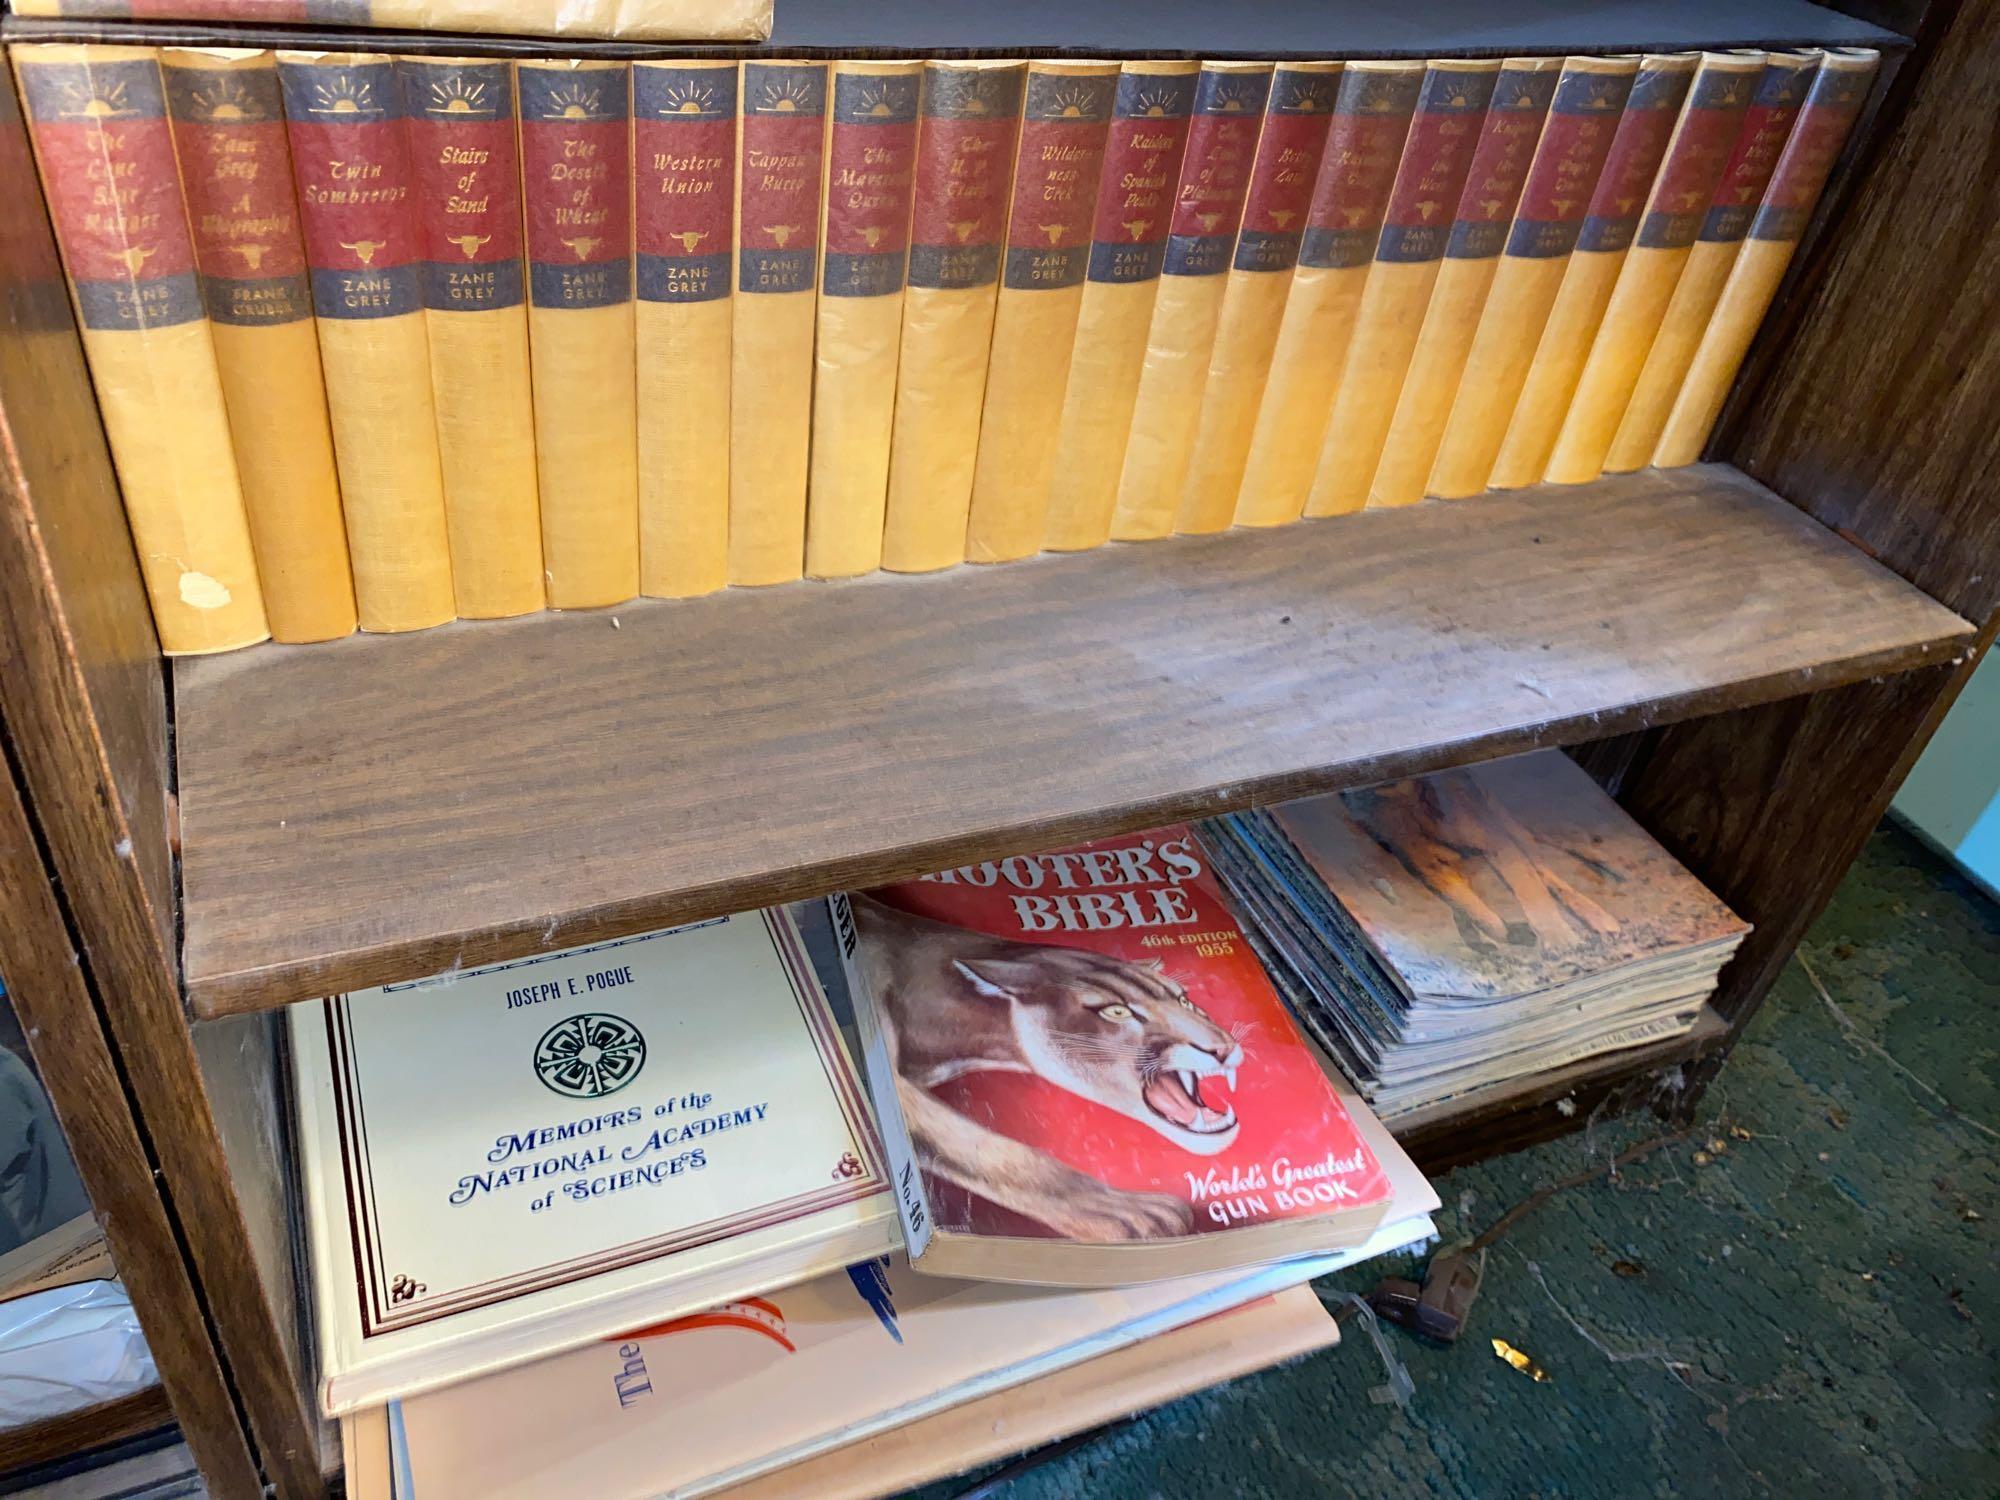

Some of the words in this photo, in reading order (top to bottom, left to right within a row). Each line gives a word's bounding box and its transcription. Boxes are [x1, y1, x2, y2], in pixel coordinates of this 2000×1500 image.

[440, 146, 489, 165] Stairs
[563, 140, 597, 158] The
[329, 160, 382, 180] Twin
[654, 153, 723, 172] Western
[458, 171, 477, 193] of
[661, 177, 714, 195] Union
[305, 185, 406, 204] Sombreros
[572, 186, 592, 205] of
[1043, 185, 1074, 201] Trek
[446, 195, 488, 214] Sand
[760, 259, 800, 271] ZANE
[1031, 256, 1068, 267] ZANE
[1114, 253, 1149, 264] ZANE
[449, 271, 495, 285] ZANE
[667, 267, 710, 280] ZANE
[760, 273, 799, 286] GREY
[1031, 268, 1065, 280] GREY
[1113, 265, 1146, 277] GREY
[340, 278, 392, 292] ZANE
[450, 285, 495, 300] GREY
[667, 280, 708, 293] GREY
[345, 293, 391, 308] GREY
[1007, 886, 1199, 932] BIBLE
[1140, 933, 1176, 949] 46th
[1178, 930, 1238, 945] EDITION
[1195, 942, 1234, 958] 1955
[506, 981, 561, 1009] JOSEPH
[567, 978, 584, 995] E.
[586, 965, 635, 992] POGUE
[487, 1106, 642, 1163] MEMOIRS
[655, 1098, 677, 1118] of
[680, 1092, 712, 1111] the
[448, 1145, 614, 1206] NATIONAL
[621, 1102, 769, 1162] ACADEMY
[1184, 1163, 1268, 1203] World's
[1271, 1147, 1367, 1191] Greatest
[530, 1191, 555, 1213] of
[899, 1158, 914, 1206] No.
[909, 1199, 925, 1233] 46
[1208, 1194, 1270, 1227] GUN
[1273, 1179, 1359, 1211] BOOK
[613, 1341, 654, 1410] The
